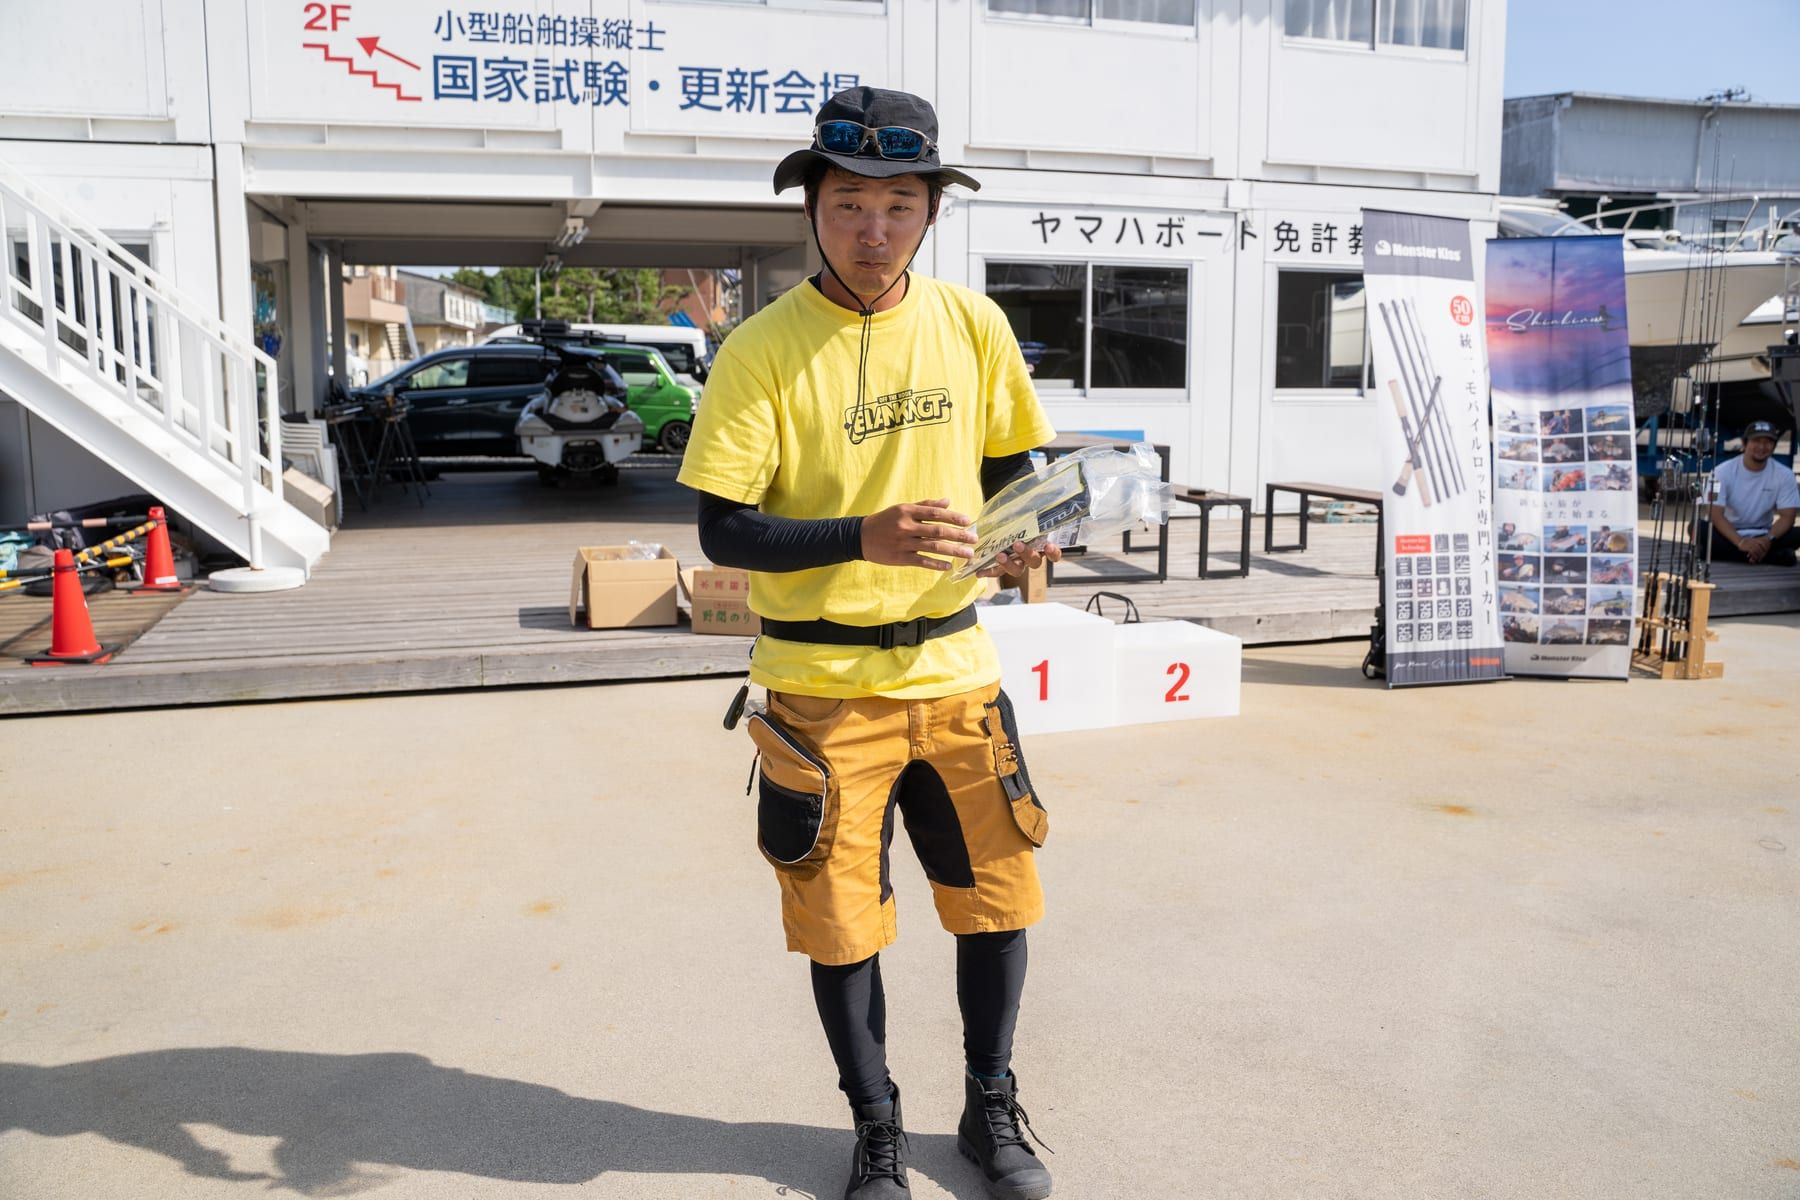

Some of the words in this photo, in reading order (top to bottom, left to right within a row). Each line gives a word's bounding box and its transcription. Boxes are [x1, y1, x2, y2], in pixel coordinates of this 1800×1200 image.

[303, 2, 352, 32] 2F
[433, 9, 666, 52] 小型船舶操縦士
[1452, 300, 1470, 315] 50
[1031, 659, 1049, 702] 1
[1164, 662, 1191, 703] 2
